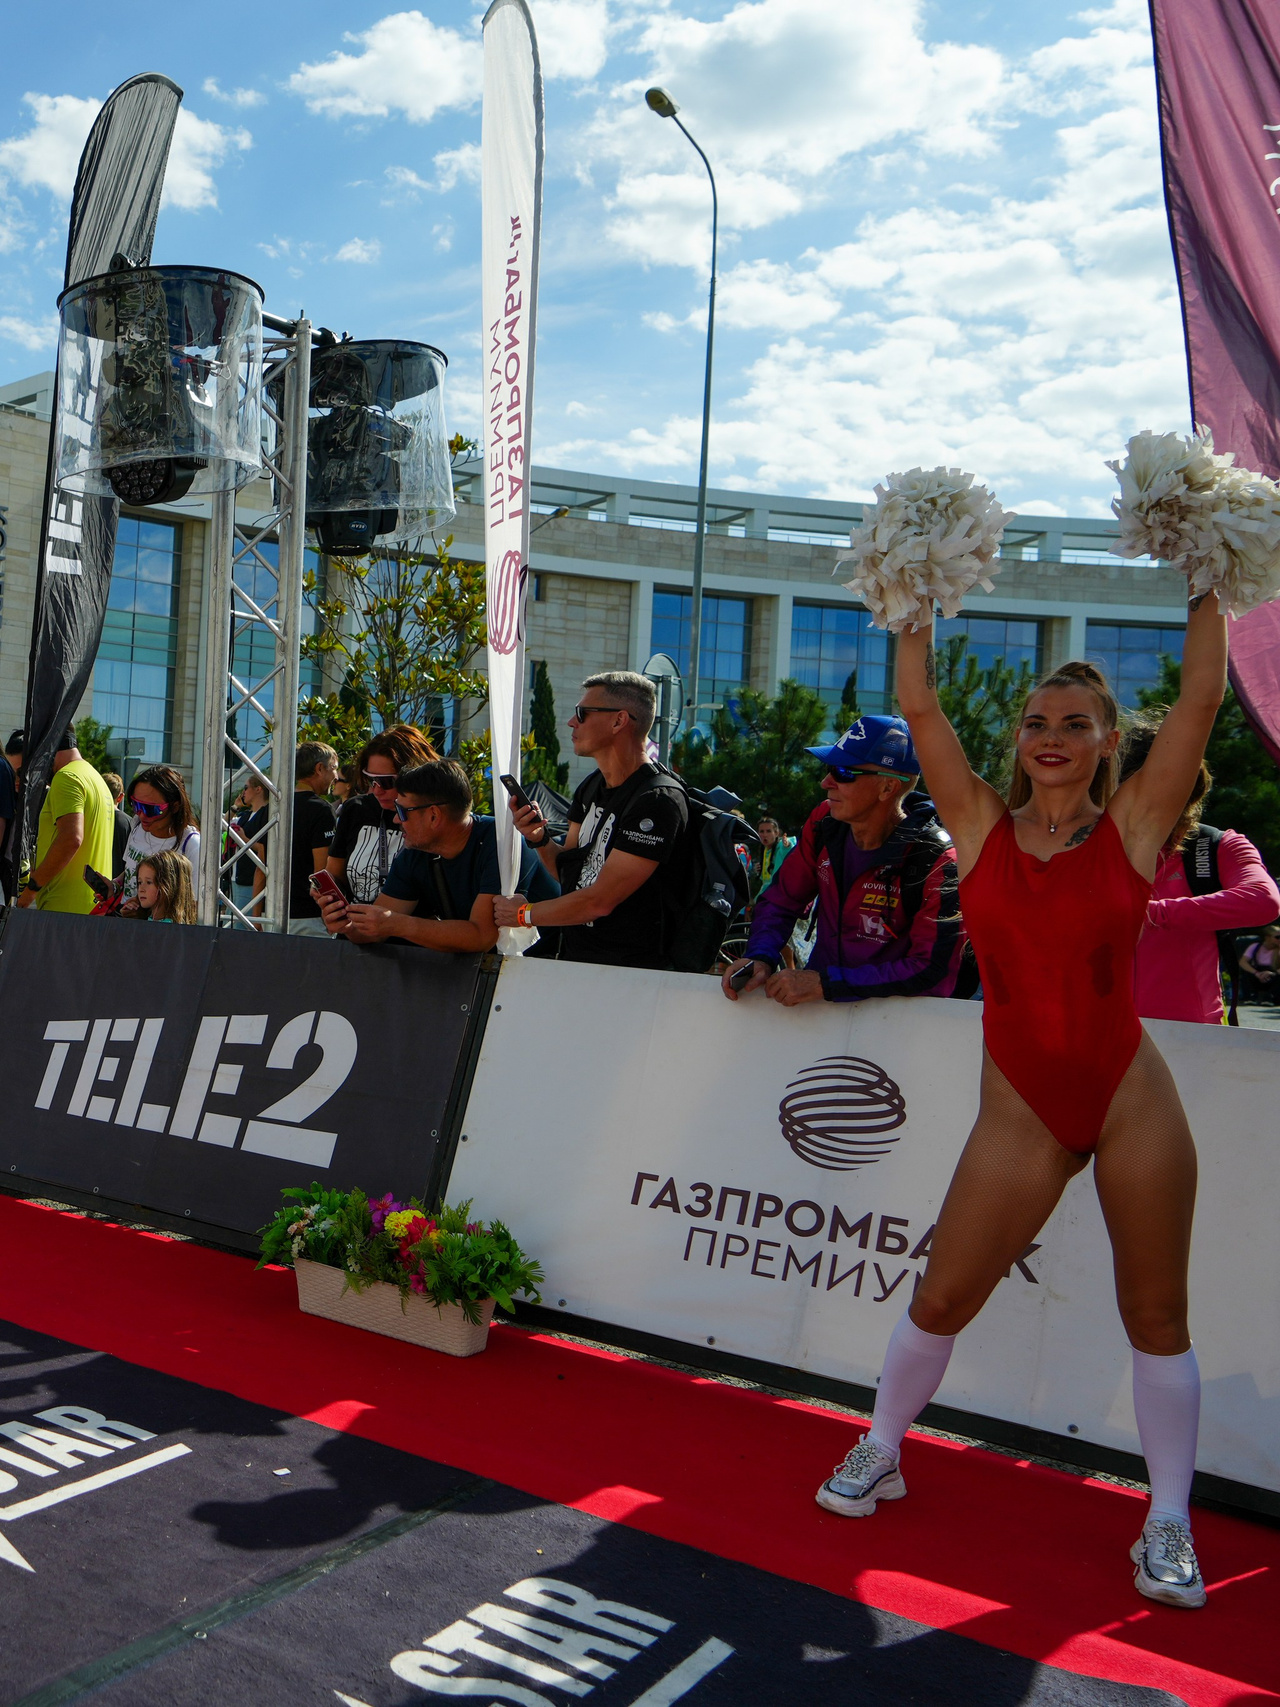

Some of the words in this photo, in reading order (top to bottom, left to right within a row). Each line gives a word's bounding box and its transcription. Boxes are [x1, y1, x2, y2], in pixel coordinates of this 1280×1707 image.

[1195, 836, 1211, 878] IRONSTAR
[33, 1010, 358, 1169] TELE2
[630, 1172, 1043, 1285] ГАЗПРОМБАК
[683, 1226, 923, 1302] ПРЕМИУ
[389, 1576, 678, 1707] STAR
